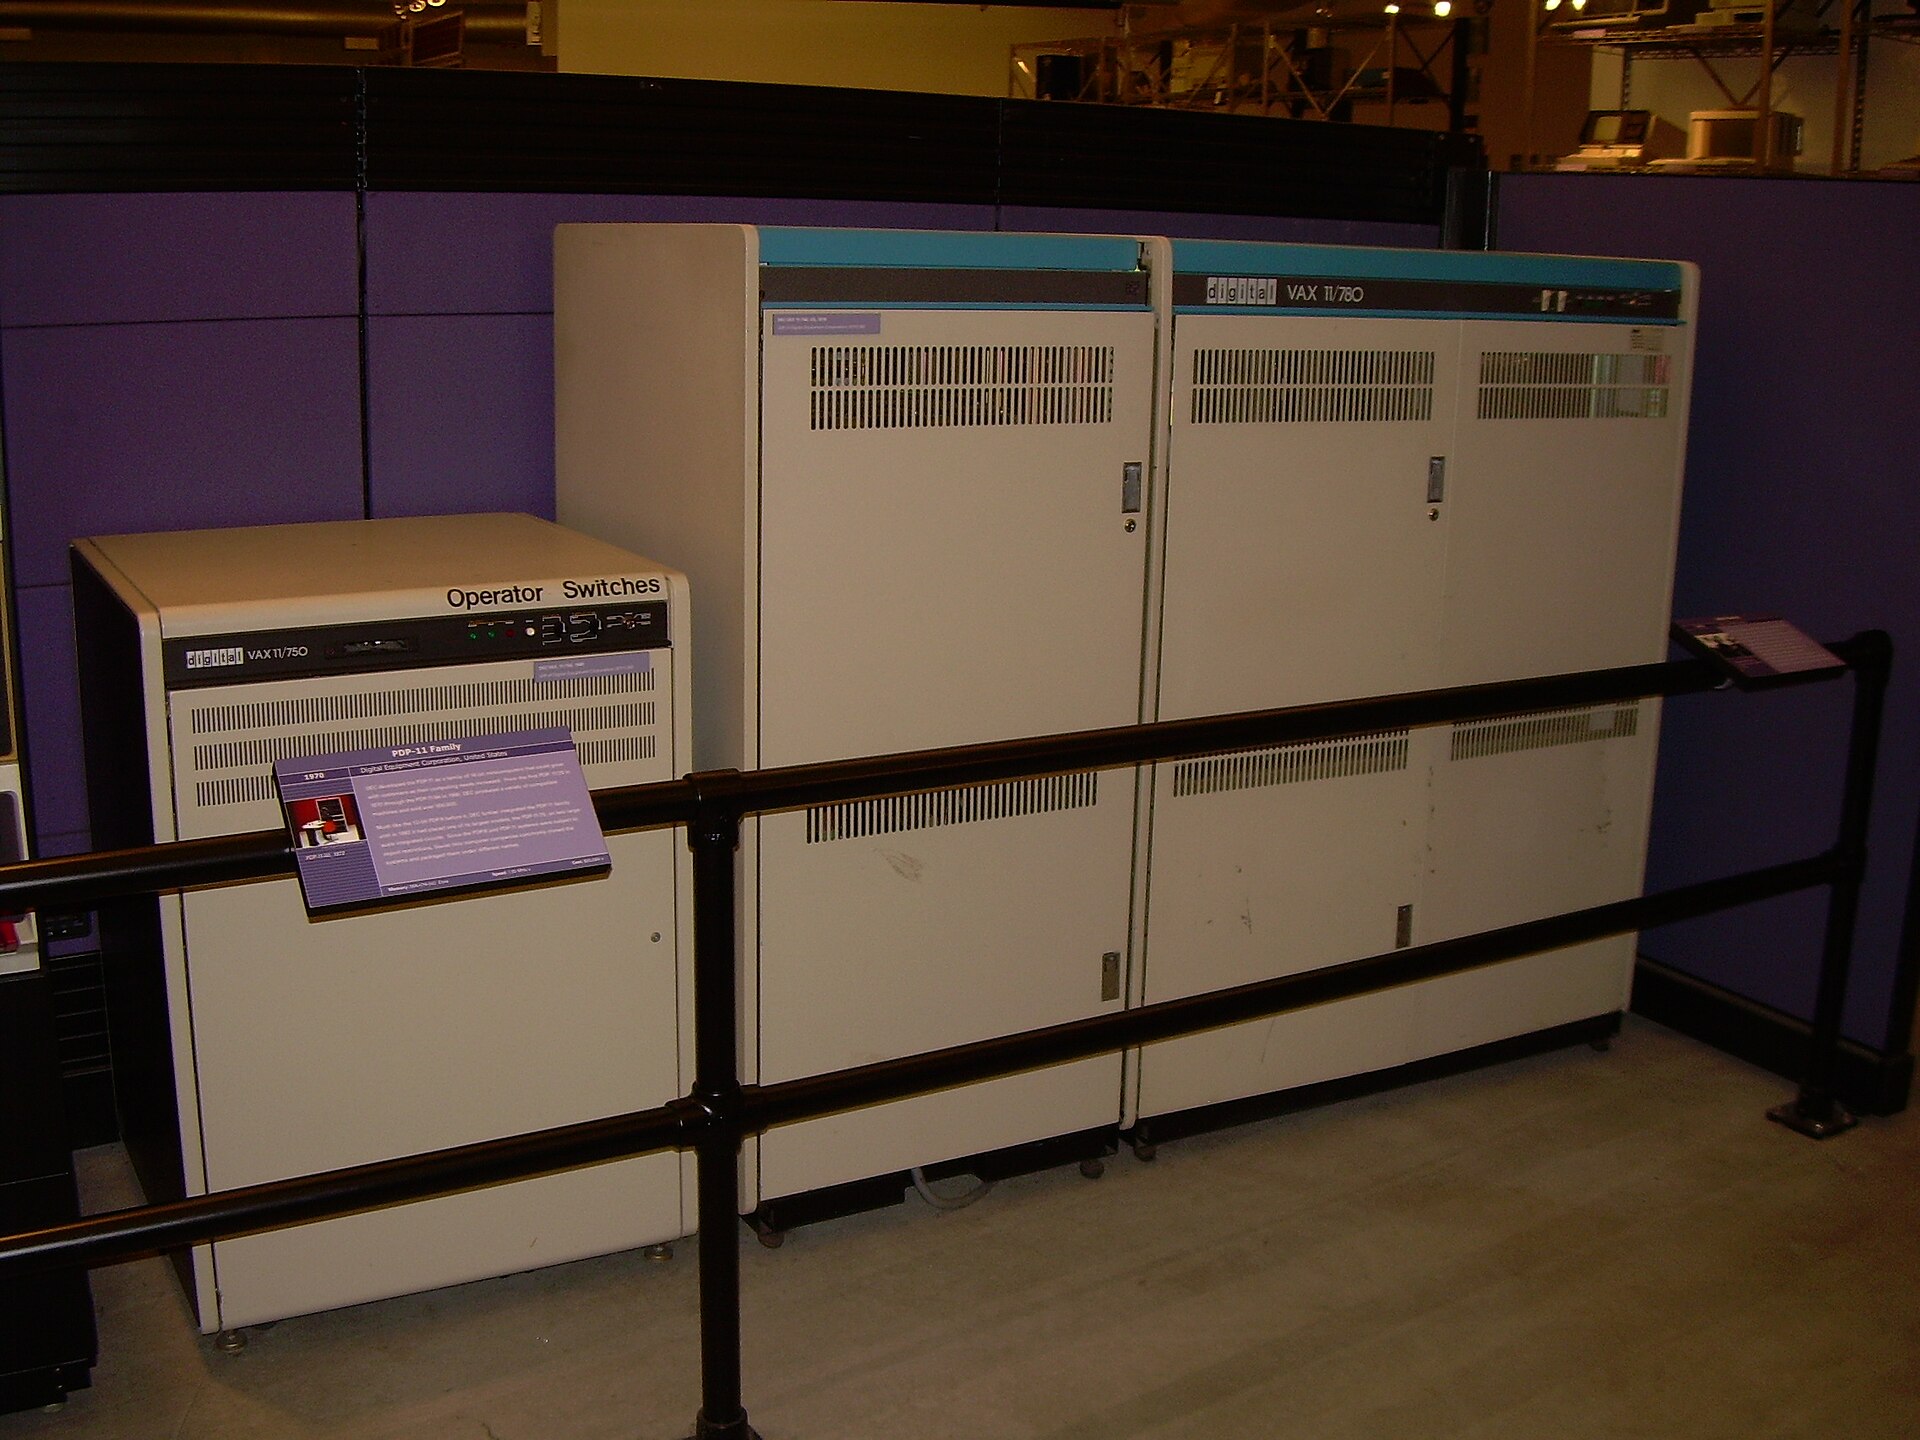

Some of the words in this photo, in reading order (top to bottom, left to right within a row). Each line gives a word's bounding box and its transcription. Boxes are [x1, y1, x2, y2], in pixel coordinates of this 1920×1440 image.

[1207, 278, 1277, 304] digital
[1287, 284, 1319, 301] VAX
[1324, 285, 1364, 302] 11/780
[447, 586, 543, 610] Operator
[563, 577, 660, 599] Switches
[187, 648, 243, 669] digital
[248, 649, 272, 660] VAX
[273, 646, 309, 660] 11/750
[360, 764, 383, 775] Digital
[384, 760, 420, 772] Equipment
[464, 752, 486, 761] United
[486, 750, 508, 758] States
[392, 746, 428, 758] PDP-11
[431, 743, 462, 753] Family
[304, 772, 325, 780] 1970
